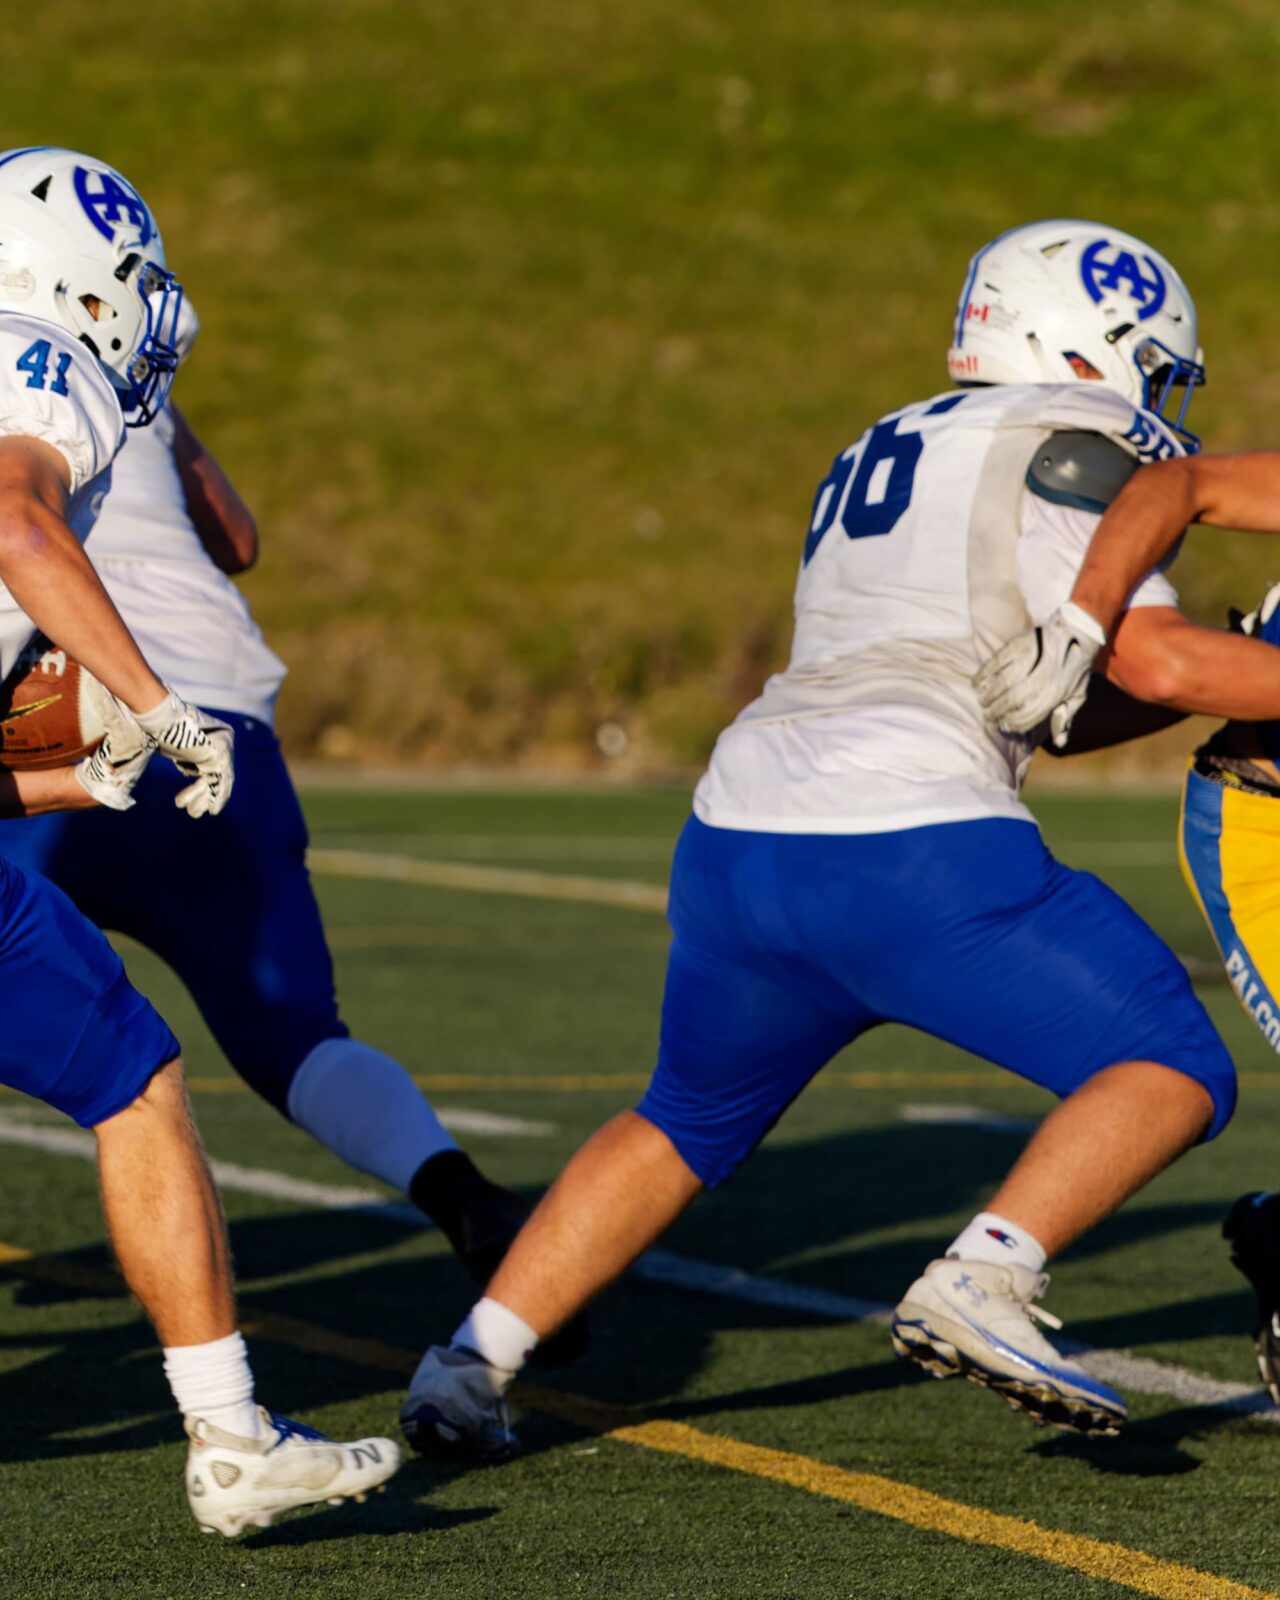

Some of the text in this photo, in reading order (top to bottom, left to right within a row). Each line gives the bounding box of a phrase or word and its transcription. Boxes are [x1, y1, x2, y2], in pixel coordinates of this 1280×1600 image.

[16, 338, 73, 398] 41
[803, 394, 968, 568] 66
[1225, 949, 1280, 1055] FALCO
